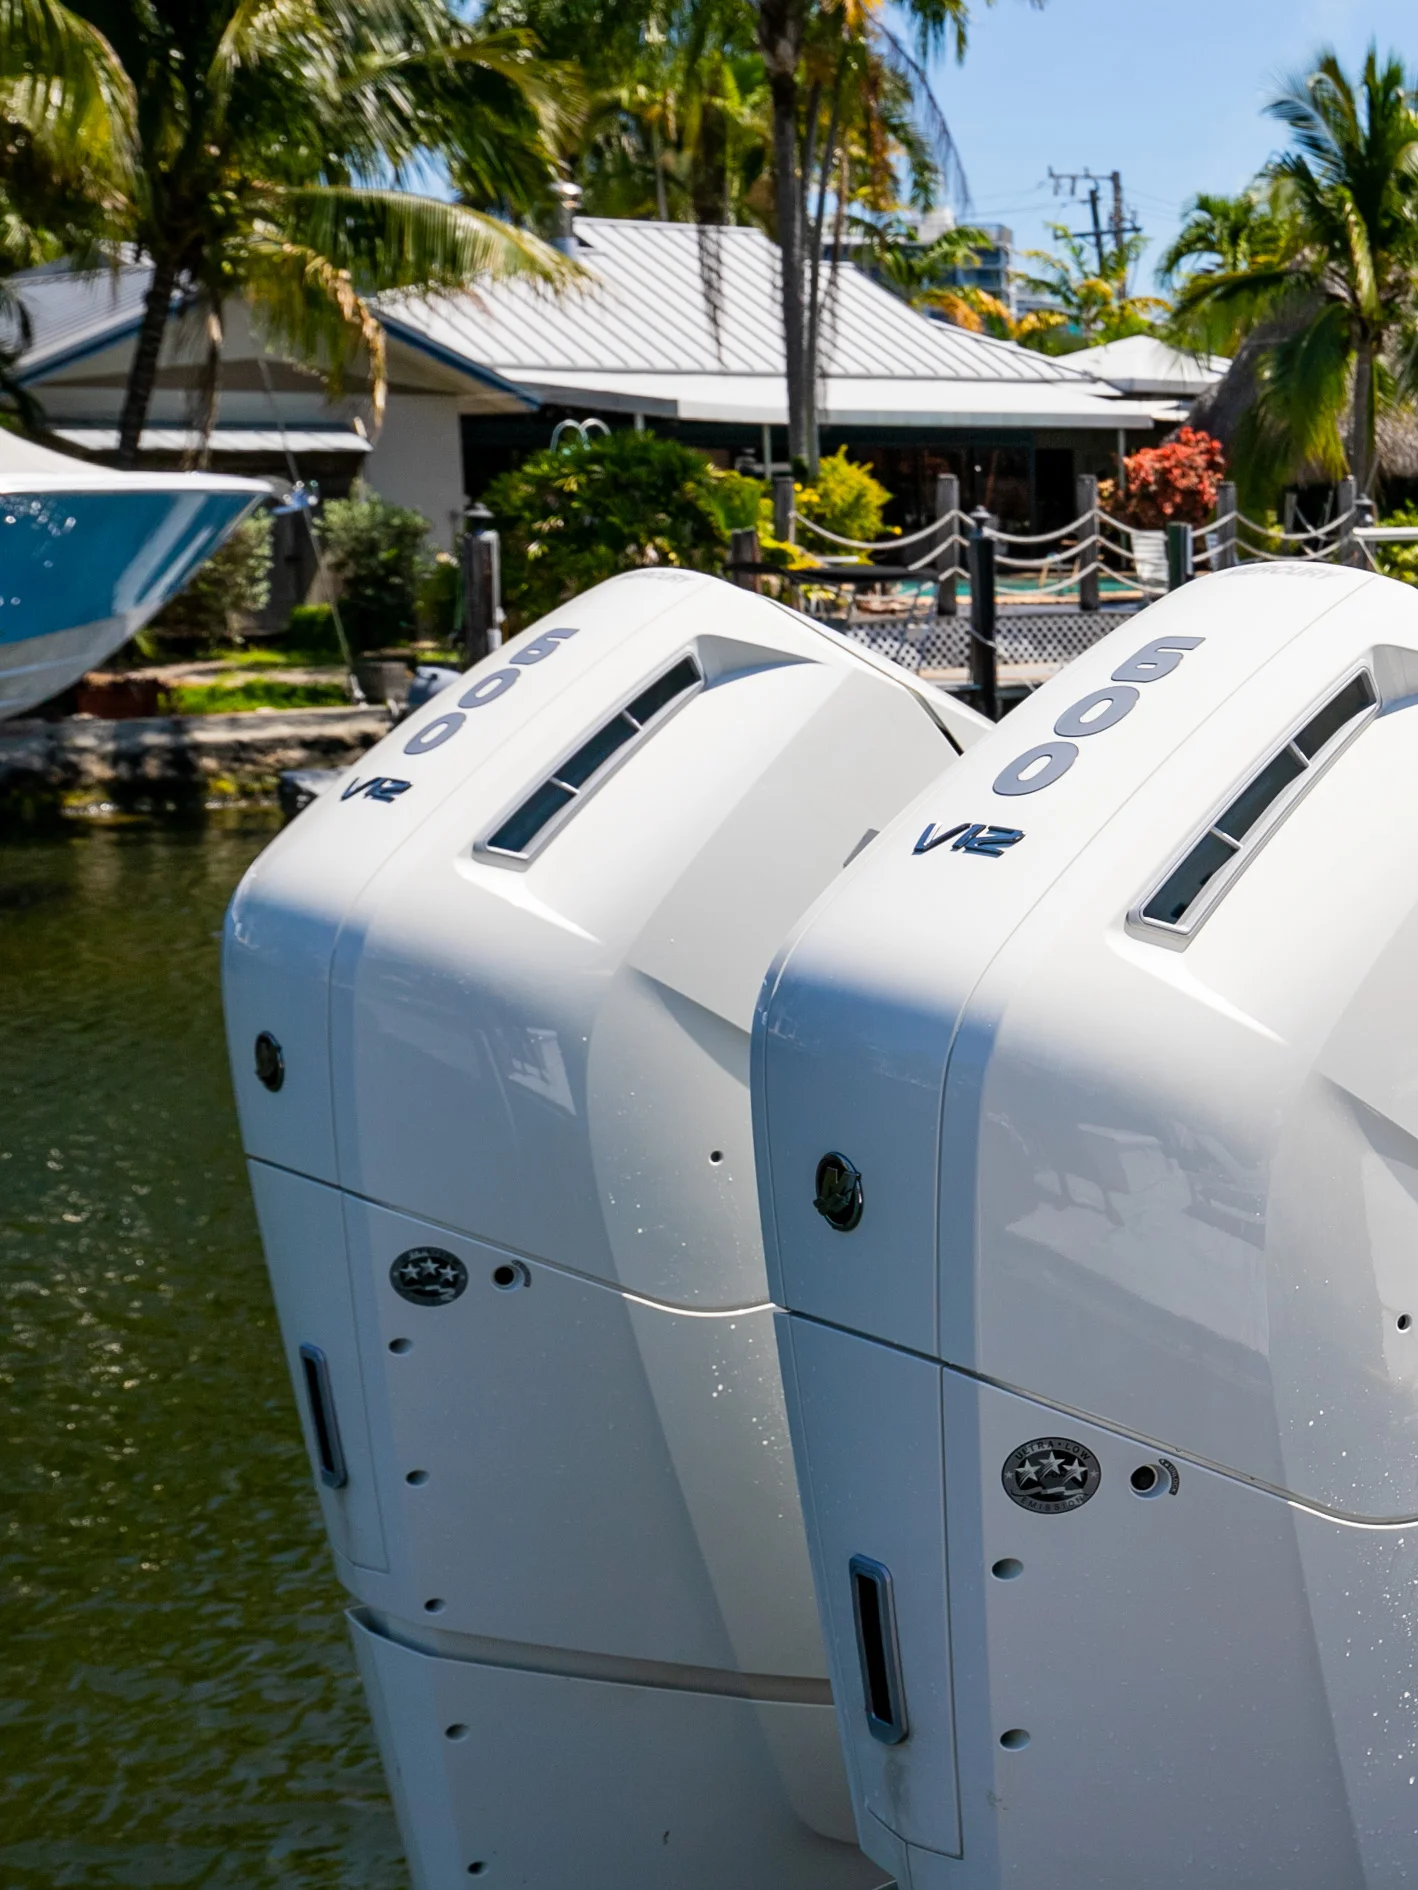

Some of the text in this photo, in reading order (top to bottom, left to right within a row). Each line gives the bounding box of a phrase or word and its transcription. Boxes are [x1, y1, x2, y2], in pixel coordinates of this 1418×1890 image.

[403, 628, 580, 755] 600
[992, 636, 1206, 796] 600
[340, 776, 414, 804] V12
[911, 822, 1027, 858] V12
[1014, 1440, 1091, 1462] ULTRA LOW
